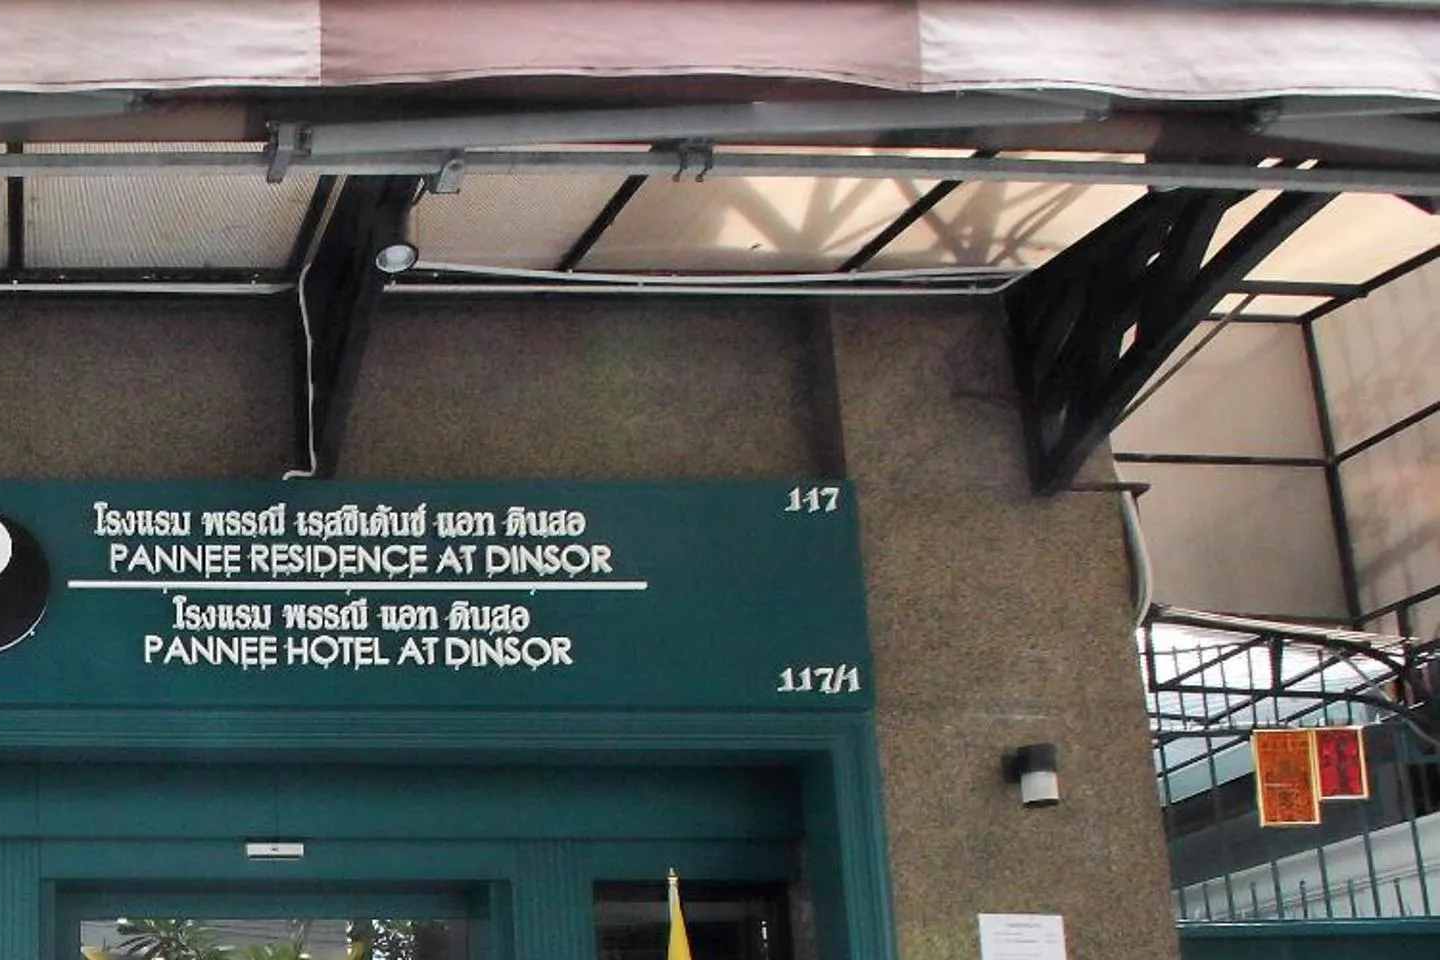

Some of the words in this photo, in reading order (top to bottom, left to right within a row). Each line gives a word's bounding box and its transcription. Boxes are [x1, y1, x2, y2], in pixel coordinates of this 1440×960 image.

[785, 486, 840, 513] 117
[94, 501, 191, 537] โรงแรม
[201, 502, 287, 537] พรรณี
[435, 510, 496, 537] แอท
[504, 506, 587, 537] ดินสอ
[110, 543, 241, 577] PANNEE
[250, 543, 428, 577] RESIDENCE
[436, 544, 477, 575] AT
[485, 543, 612, 577] DINSOR
[172, 594, 272, 631] โรงแรม
[284, 597, 368, 631] พรรณี
[380, 604, 440, 632] แอท
[447, 600, 530, 634] ดินสอ
[144, 635, 277, 669] PANNEE
[286, 634, 390, 669] HOTEL
[397, 636, 440, 666] AT
[445, 636, 573, 669] DINSOR
[777, 664, 861, 694] 117/1
